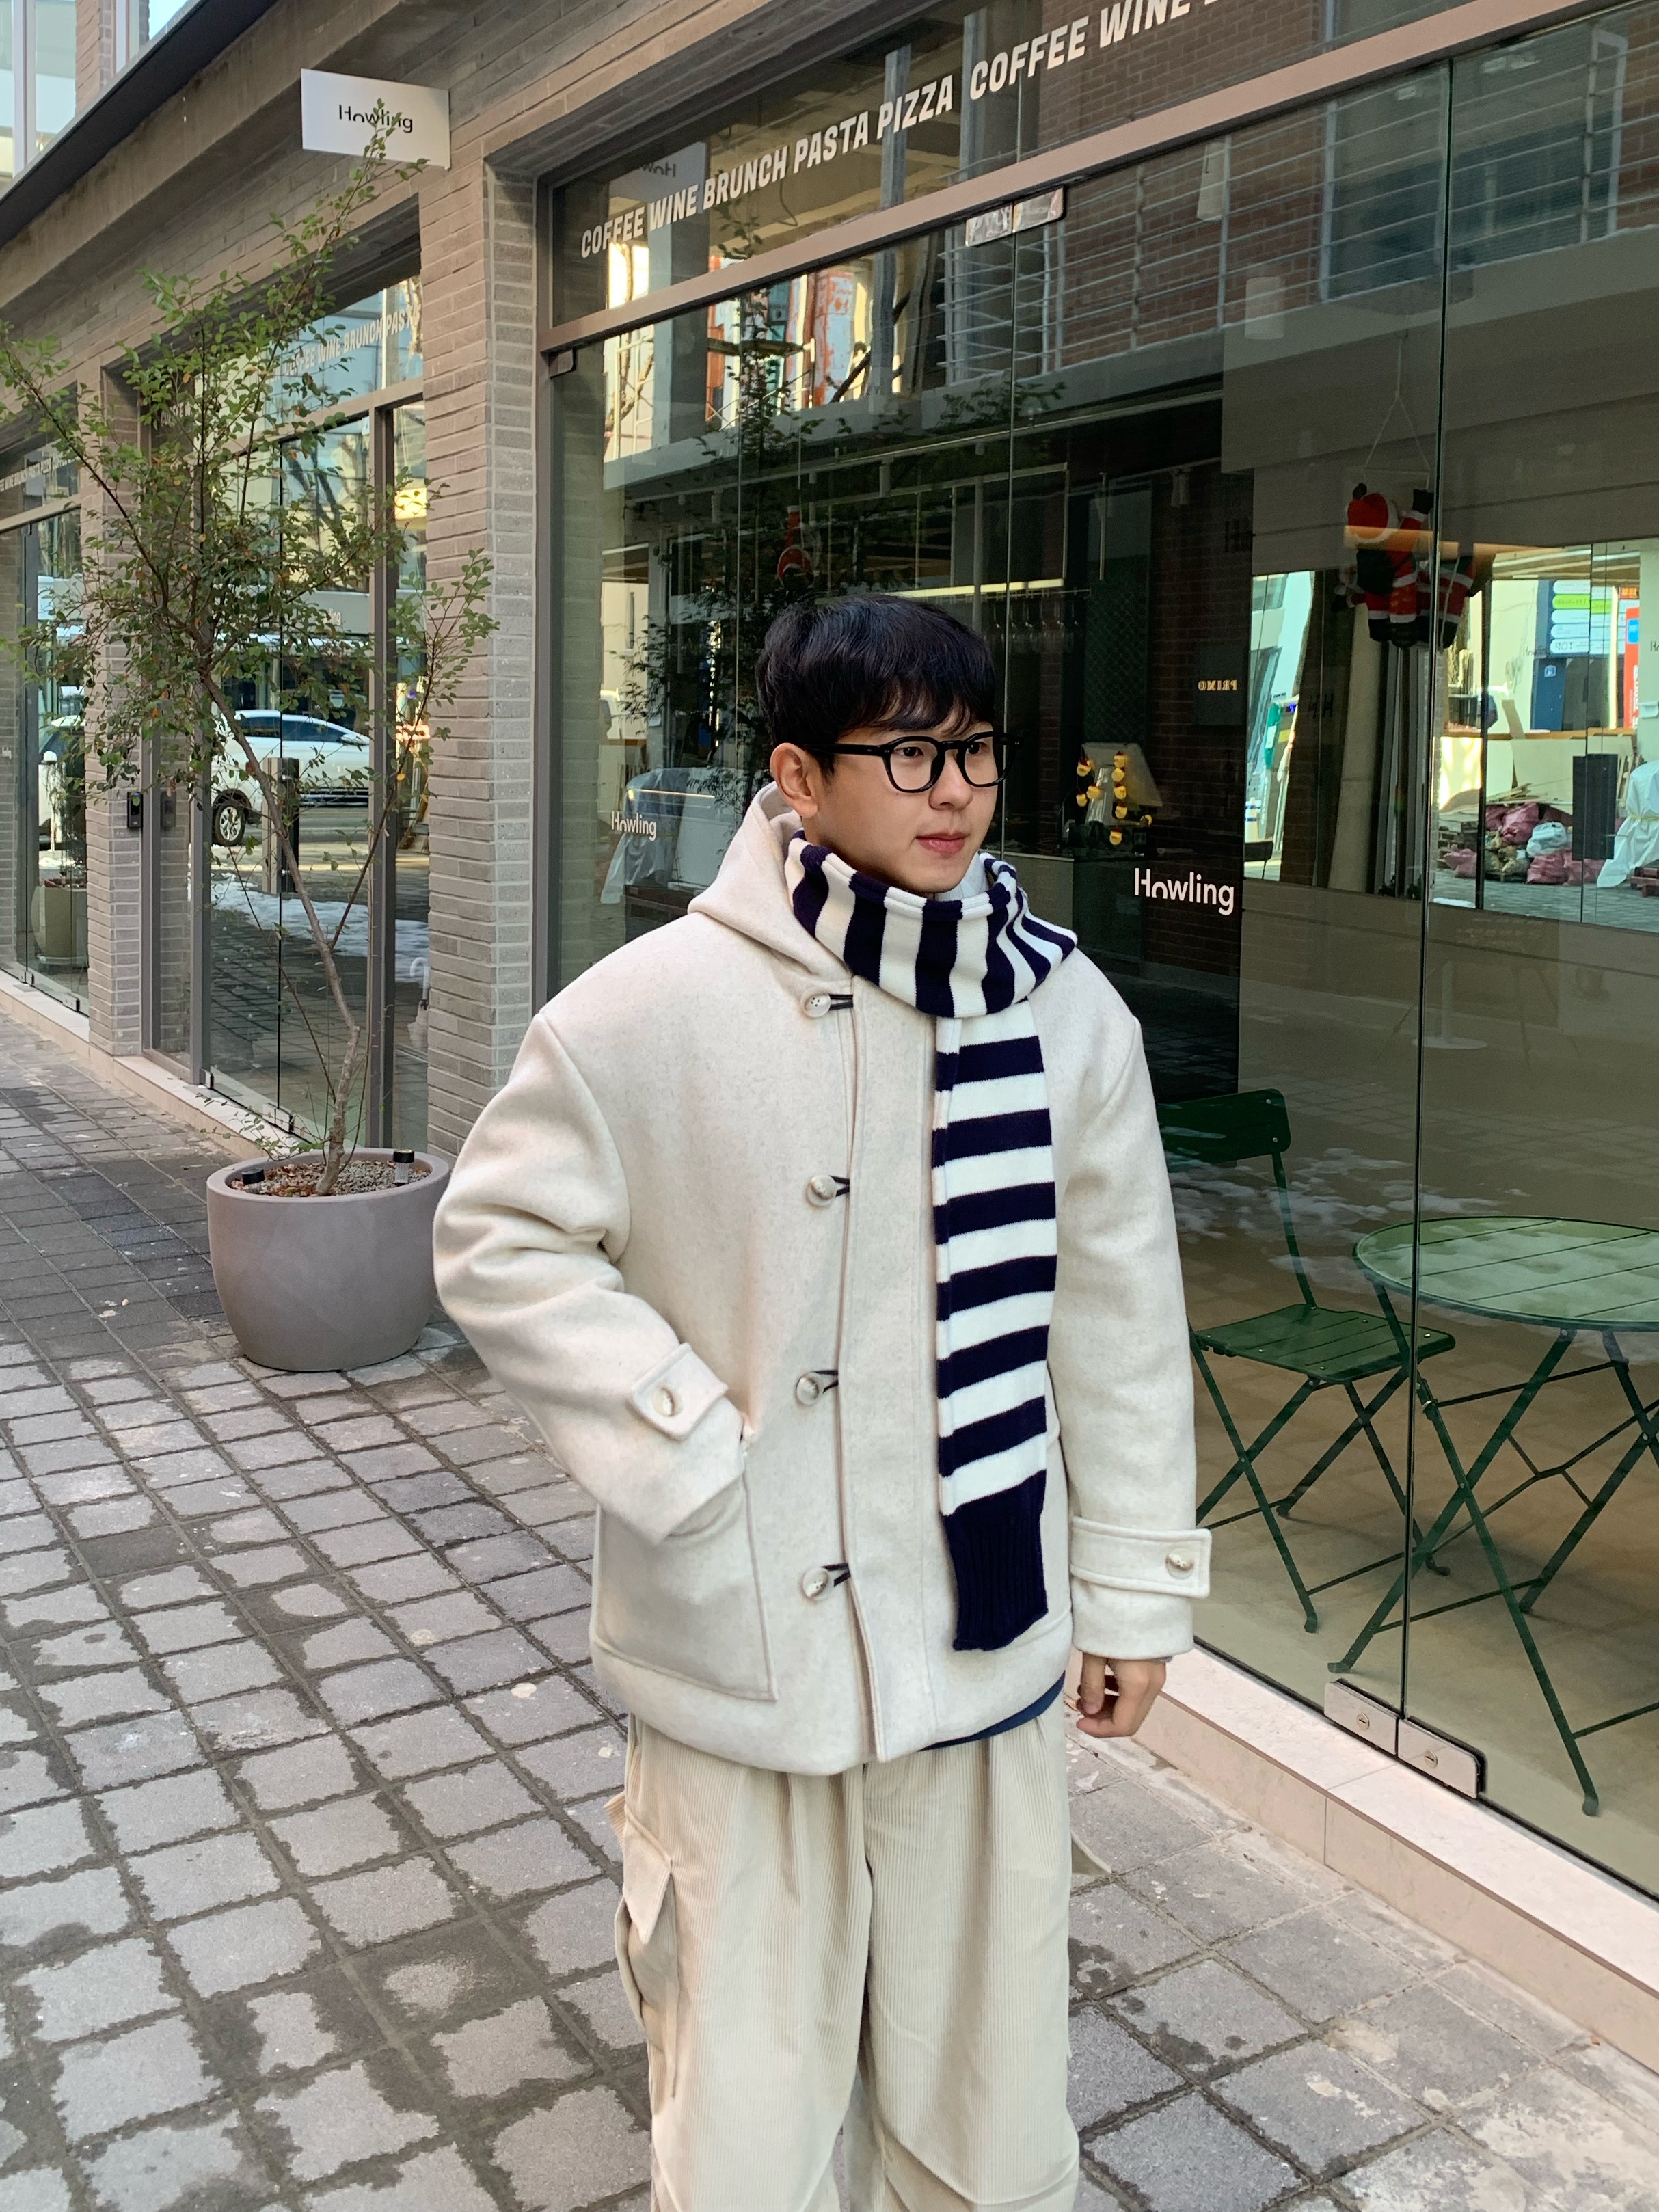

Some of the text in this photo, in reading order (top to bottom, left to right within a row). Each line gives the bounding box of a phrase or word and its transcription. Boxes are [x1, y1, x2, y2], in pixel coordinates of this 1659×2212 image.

[582, 206, 645, 258] COFFEE
[649, 184, 699, 232] WINE
[703, 146, 787, 210] BRUNCH
[794, 111, 869, 174] PASTA
[876, 75, 953, 140] PIZZA
[969, 16, 1089, 100] COFFEE
[318, 336, 341, 364] WINE
[343, 317, 383, 353] BRUNCH
[611, 811, 657, 841] Howling
[1134, 867, 1235, 916] Howling
